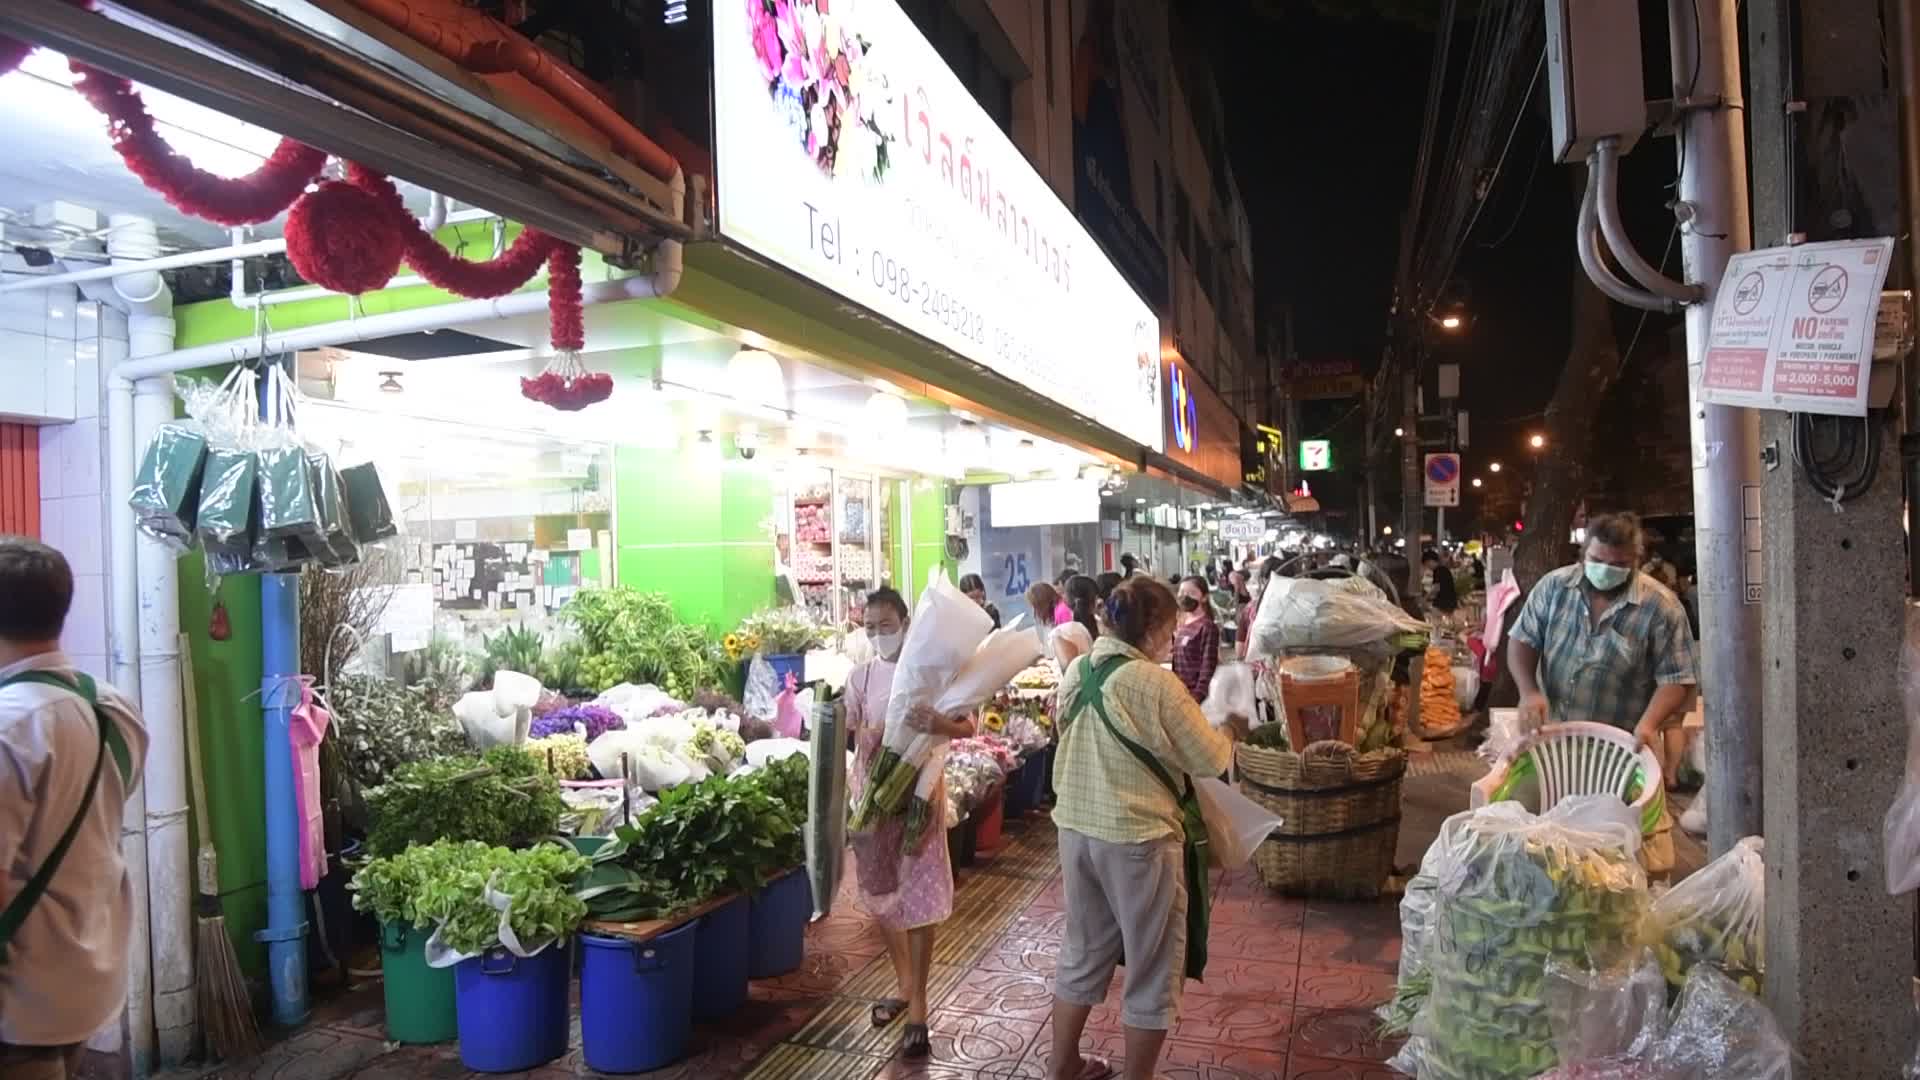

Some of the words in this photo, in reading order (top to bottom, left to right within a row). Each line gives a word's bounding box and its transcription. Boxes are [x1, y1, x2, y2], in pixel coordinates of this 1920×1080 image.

[802, 200, 841, 265] Tel
[872, 250, 985, 345] 098-2495218
[1792, 316, 1818, 340] NO
